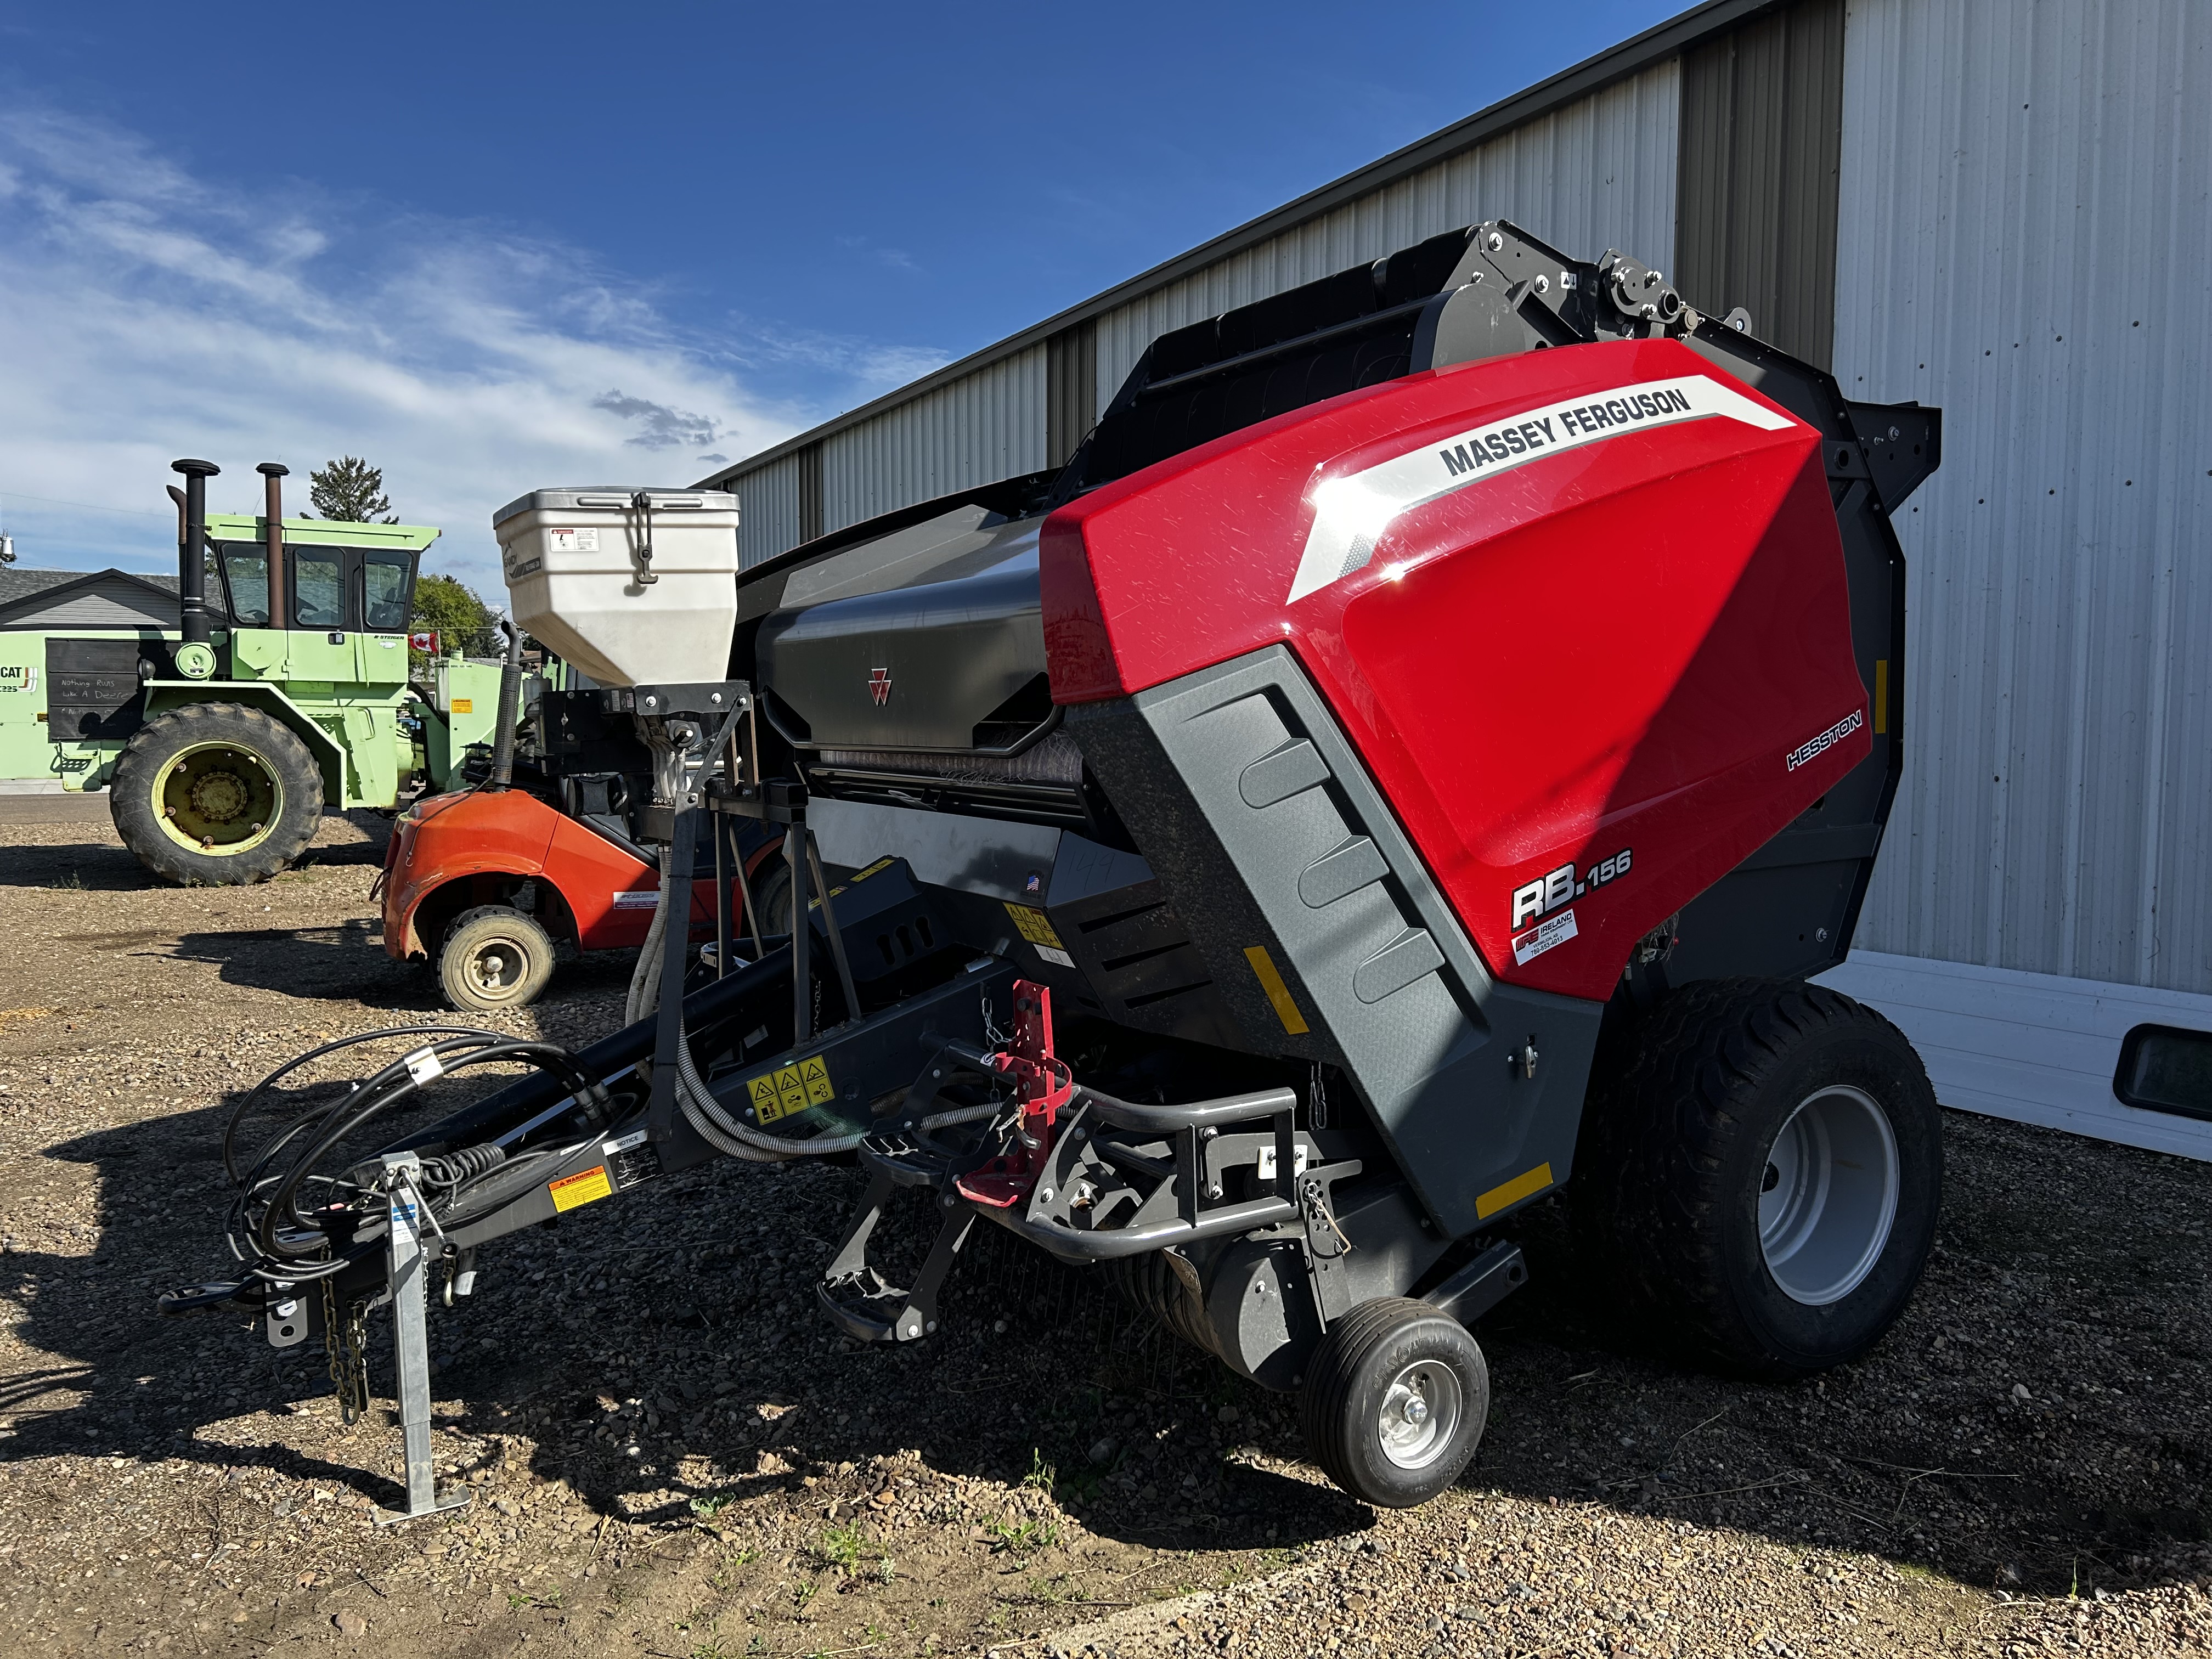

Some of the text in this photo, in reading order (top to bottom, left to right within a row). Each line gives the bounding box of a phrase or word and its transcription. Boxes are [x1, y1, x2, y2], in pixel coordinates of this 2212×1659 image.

[1440, 388, 1691, 477] MASSEY FERGUSON
[94, 690, 129, 699] Deere
[1787, 710, 1862, 771] HESSTON
[1064, 852, 1115, 891] 149
[1541, 912, 1572, 934] IRELAND
[1530, 935, 1563, 956] 780-853-4013
[617, 1135, 640, 1147] NOTICE
[565, 1170, 595, 1183] WARNING
